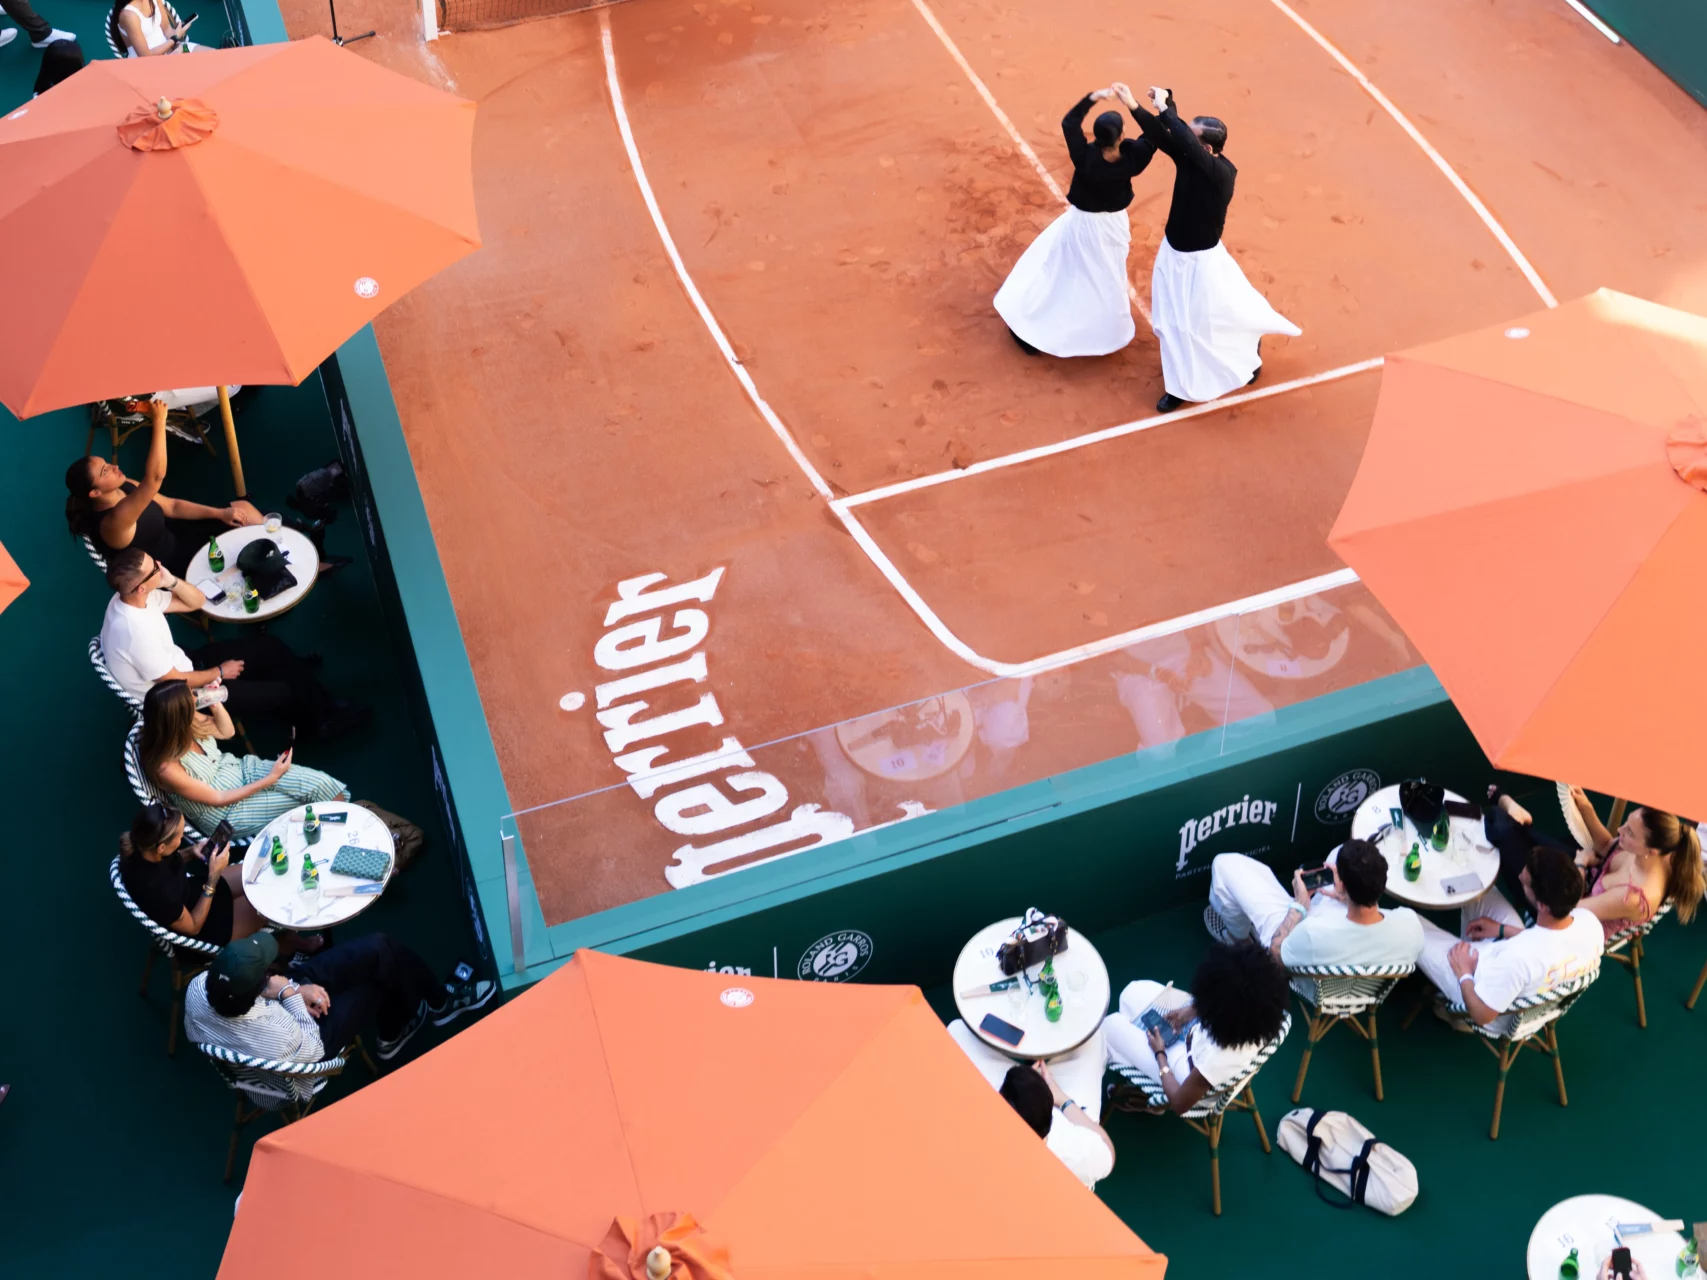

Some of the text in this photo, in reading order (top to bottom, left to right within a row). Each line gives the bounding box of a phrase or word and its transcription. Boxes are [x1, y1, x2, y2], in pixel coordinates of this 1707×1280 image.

[1176, 794, 1277, 871] perrier
[1175, 864, 1213, 880] PARTEN
[802, 933, 869, 975] ROLAND GARROS
